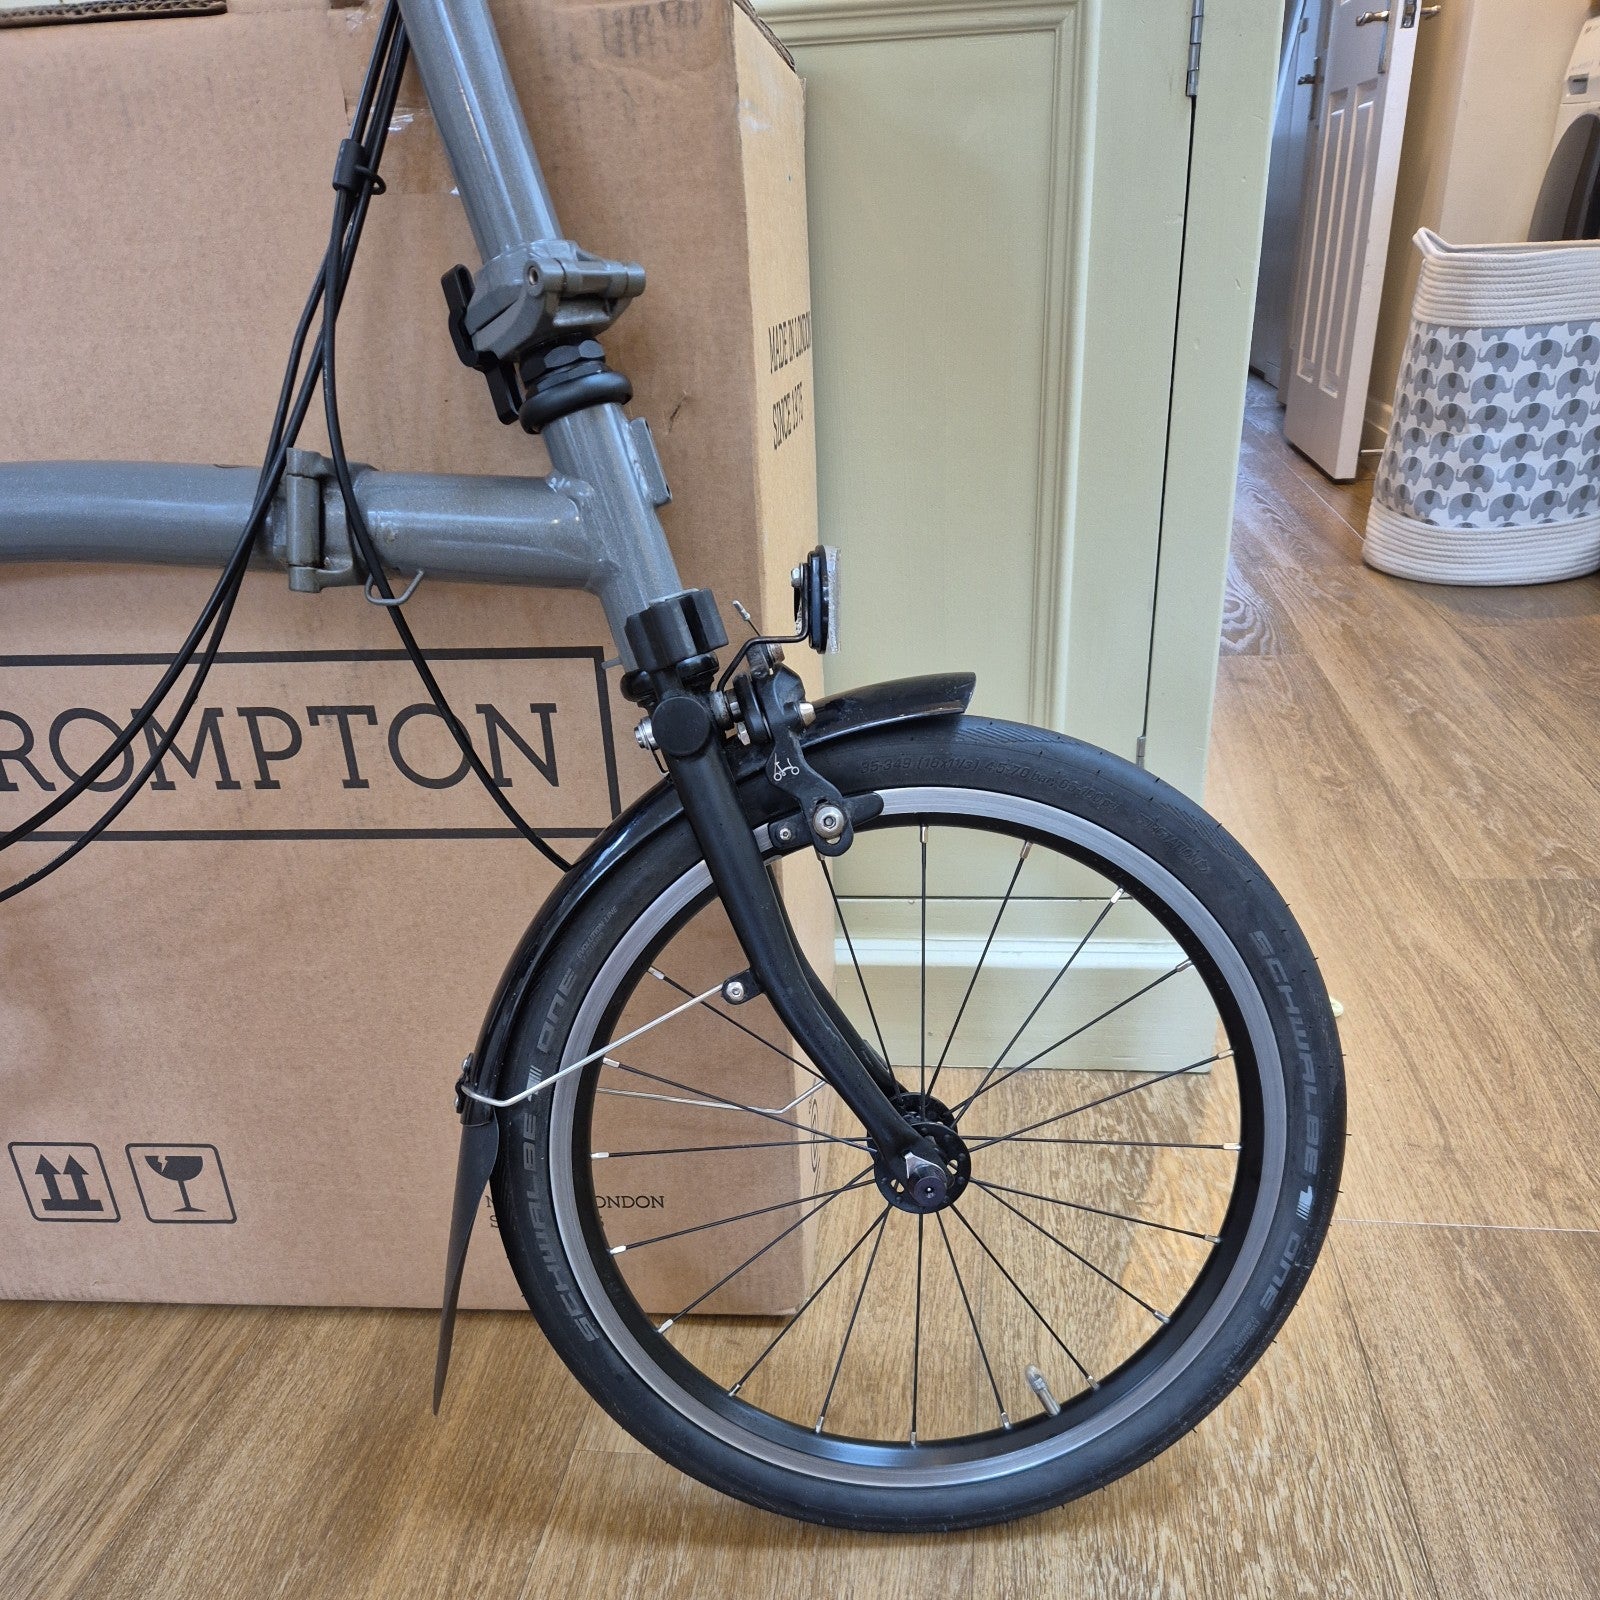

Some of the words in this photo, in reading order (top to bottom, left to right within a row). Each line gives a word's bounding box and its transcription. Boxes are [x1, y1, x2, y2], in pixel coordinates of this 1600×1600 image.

[768, 321, 788, 374] MADE
[773, 393, 791, 450] SINCE
[0, 703, 559, 792] ROMPTON
[577, 922, 605, 960] EVOLUTION
[603, 905, 618, 924] LINE
[1248, 930, 1320, 1175] SCHWALBE
[523, 1112, 600, 1343] SCHWALBE
[595, 1195, 664, 1209] ONDON
